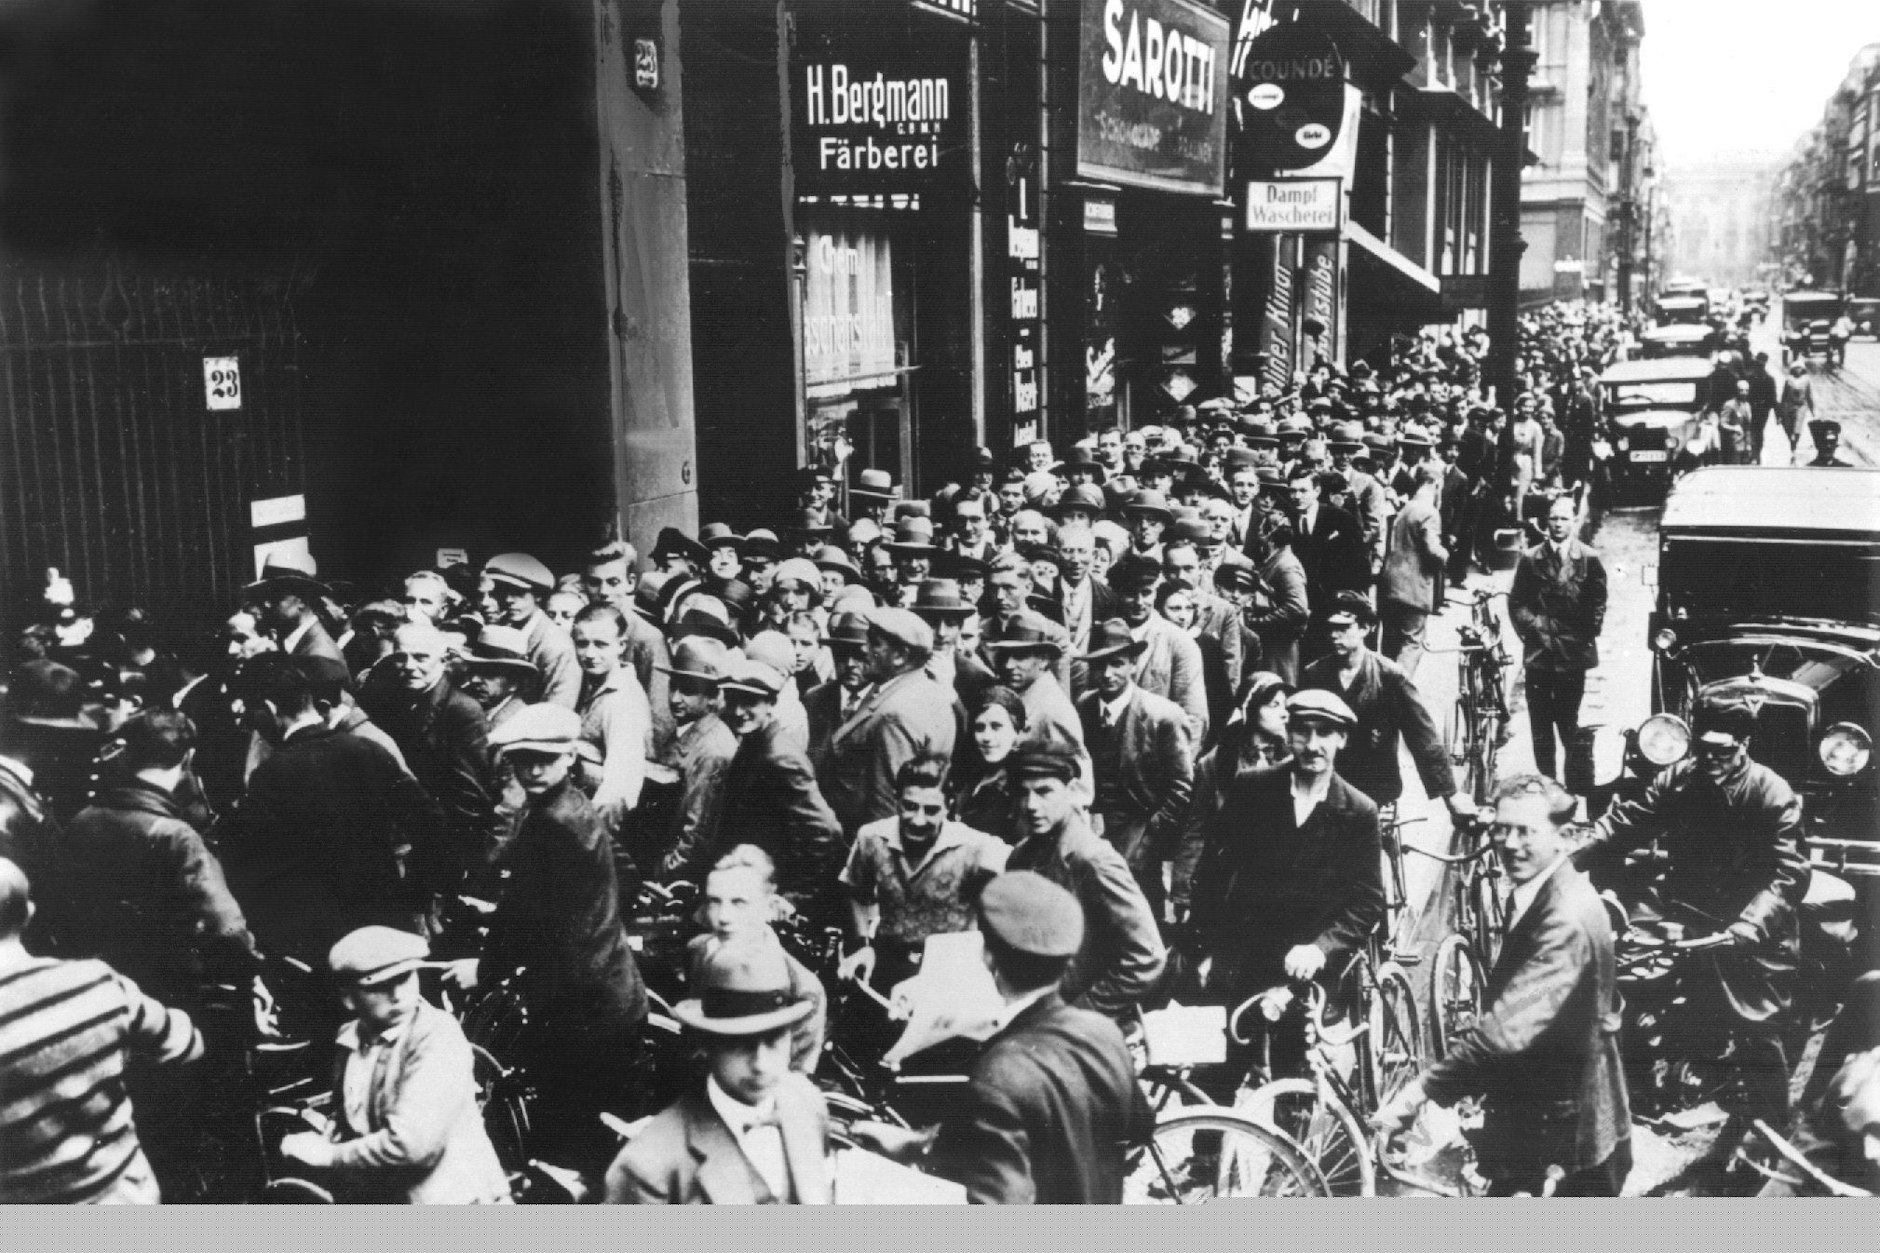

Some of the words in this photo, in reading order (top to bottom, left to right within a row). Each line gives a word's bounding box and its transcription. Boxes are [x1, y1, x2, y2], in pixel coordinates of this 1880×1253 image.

[1102, 0, 1216, 115] SAROTTI
[820, 136, 938, 170] Färberei
[1267, 184, 1317, 205] Dampf
[211, 370, 238, 398] 23
